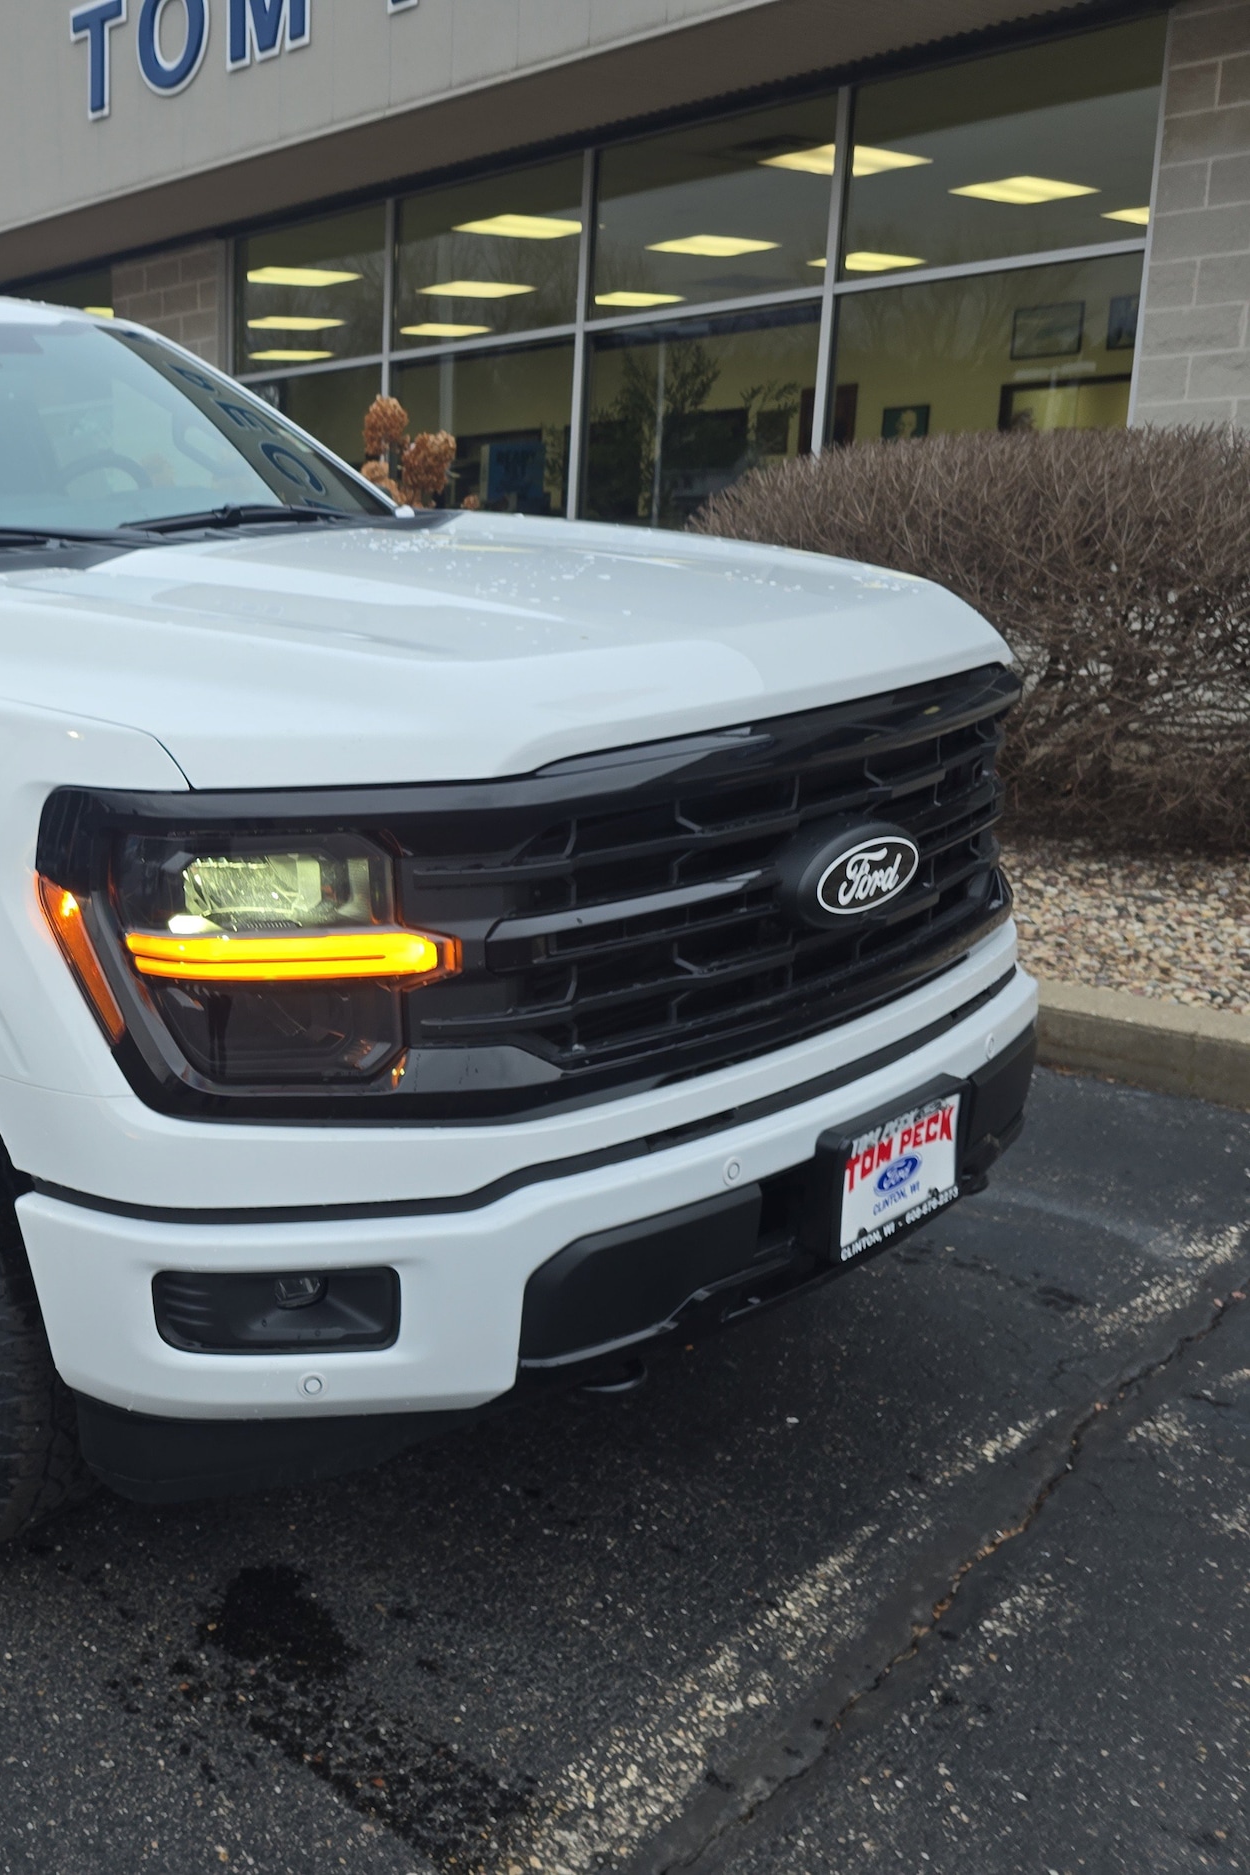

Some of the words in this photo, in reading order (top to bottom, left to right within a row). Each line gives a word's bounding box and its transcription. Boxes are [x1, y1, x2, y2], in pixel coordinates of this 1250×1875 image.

[70, 0, 310, 121] TOM
[838, 847, 902, 906] Ford
[845, 1137, 893, 1194] TOM
[899, 1105, 954, 1155] PECK
